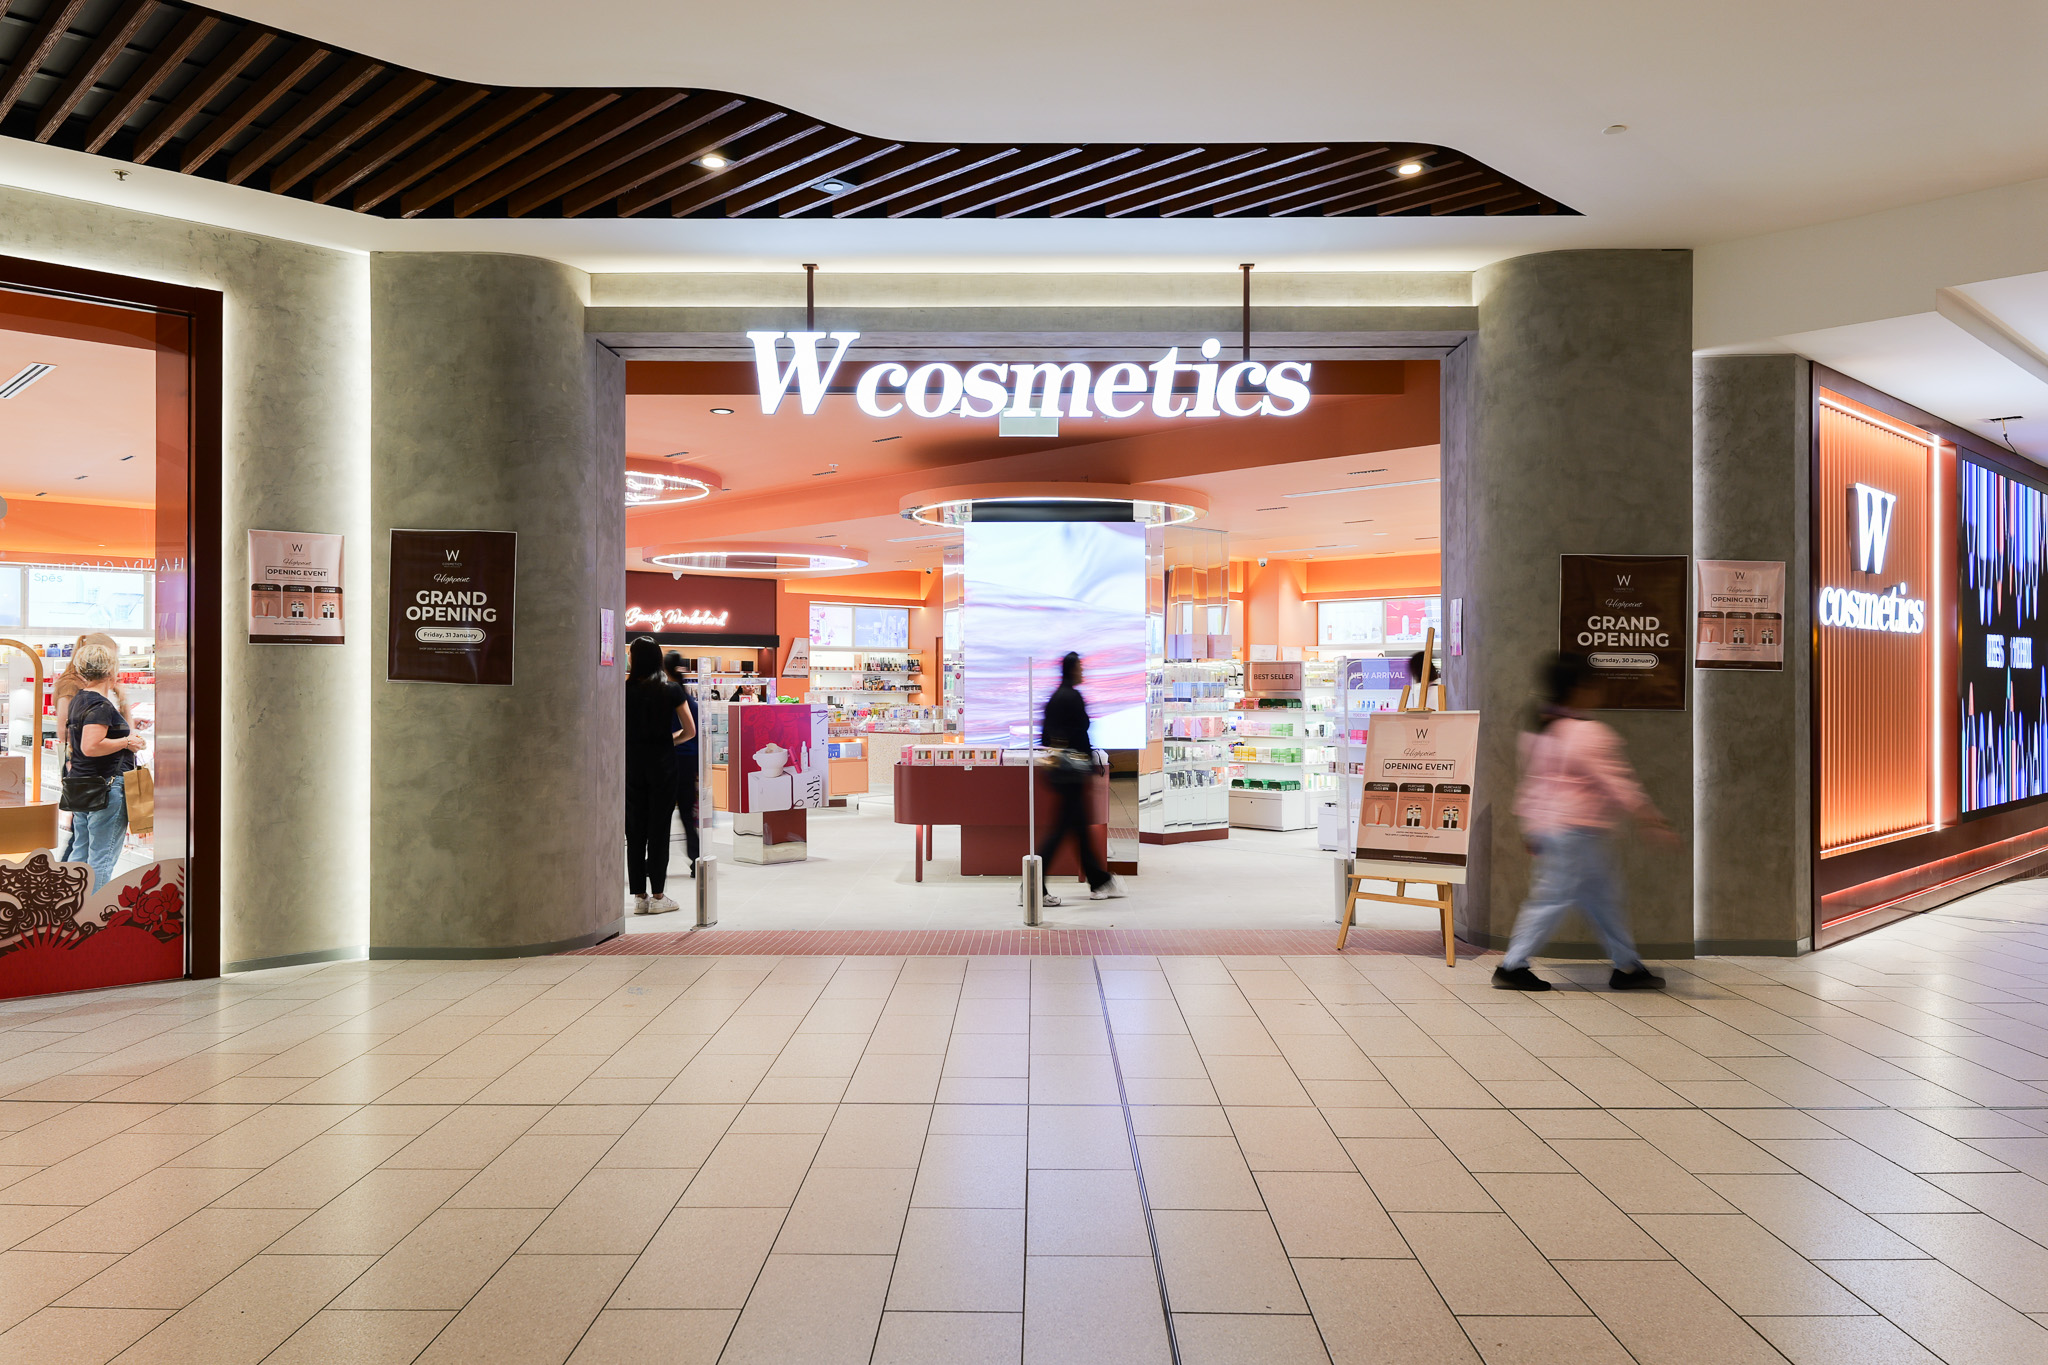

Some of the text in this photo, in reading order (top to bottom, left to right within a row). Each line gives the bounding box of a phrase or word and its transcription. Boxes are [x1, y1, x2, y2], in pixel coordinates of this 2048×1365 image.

[746, 330, 1312, 418] W cosmetics
[1854, 482, 1897, 575] W
[292, 544, 303, 552] W
[445, 549, 460, 561] W
[433, 573, 471, 584] Highpoint
[1617, 574, 1631, 586] W
[1735, 571, 1746, 580] W
[416, 590, 488, 606] GRAND
[1605, 598, 1643, 609] Highpoint
[406, 606, 497, 622] OPENING
[1819, 582, 1925, 634] cosmetics
[625, 606, 729, 633] Beauty Wonderland
[1587, 615, 1660, 631] GRAND
[452, 632, 478, 640] January
[1577, 632, 1669, 647] OPENING
[1630, 657, 1655, 665] January
[1351, 671, 1405, 679] NEW ARRIVAL
[1416, 728, 1429, 739] W
[1385, 762, 1454, 771] OPENING EVENT
